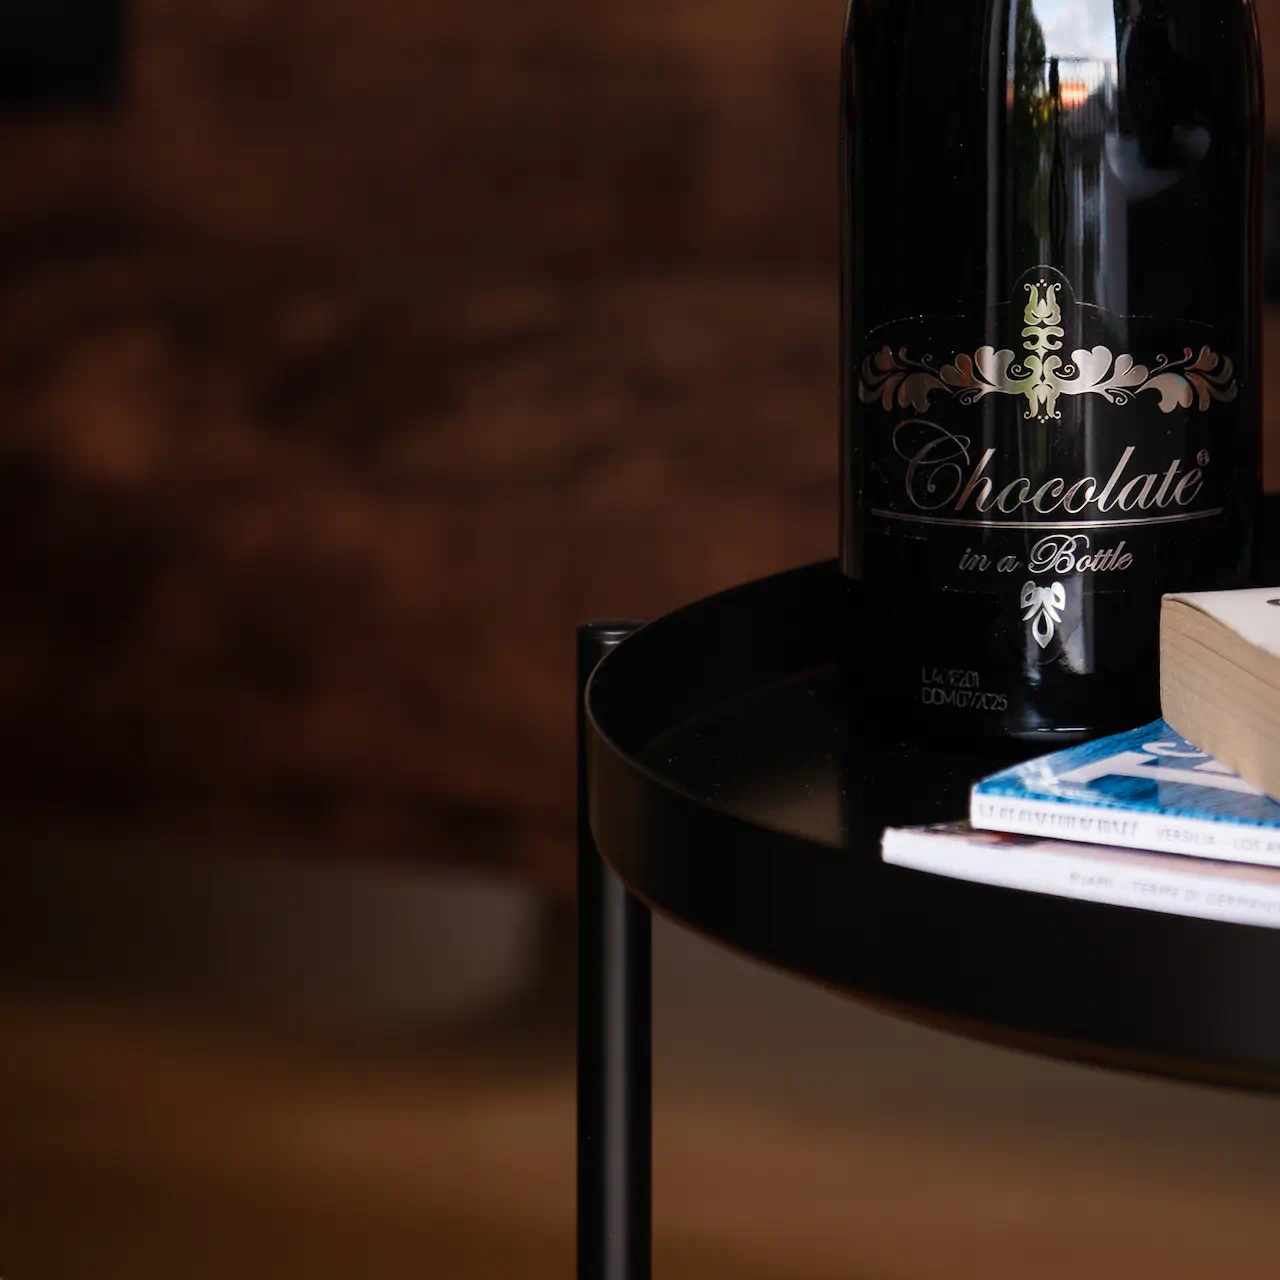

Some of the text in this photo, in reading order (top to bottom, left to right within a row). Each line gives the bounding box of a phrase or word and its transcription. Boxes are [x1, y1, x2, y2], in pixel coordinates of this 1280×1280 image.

[959, 534, 1133, 574] in a Bottle
